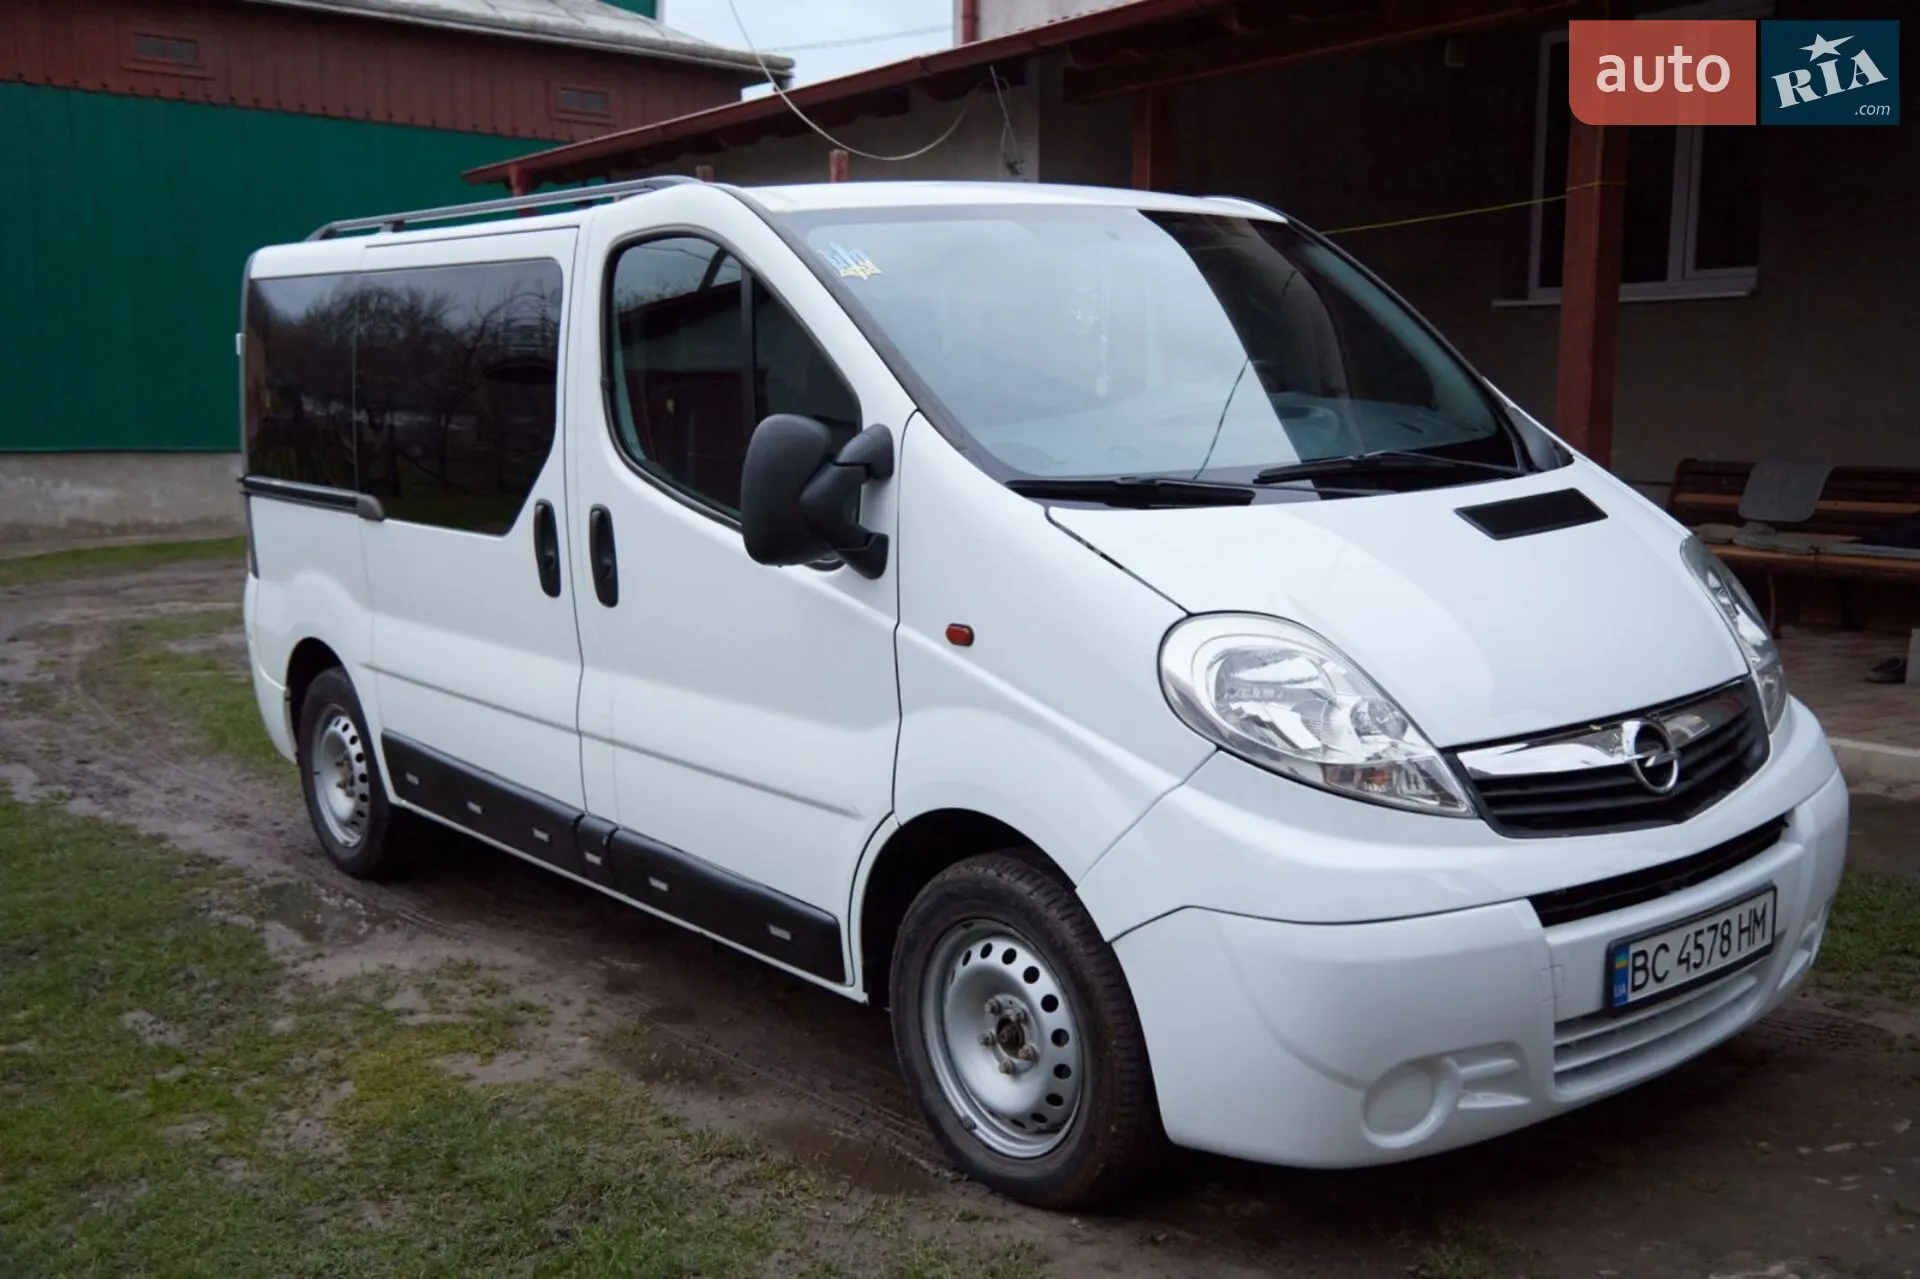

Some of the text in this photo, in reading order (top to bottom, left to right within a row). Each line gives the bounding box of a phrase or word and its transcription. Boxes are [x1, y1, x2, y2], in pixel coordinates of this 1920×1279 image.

[1631, 902, 1767, 992] BC 4578 HM
[1613, 983, 1627, 997] UA
